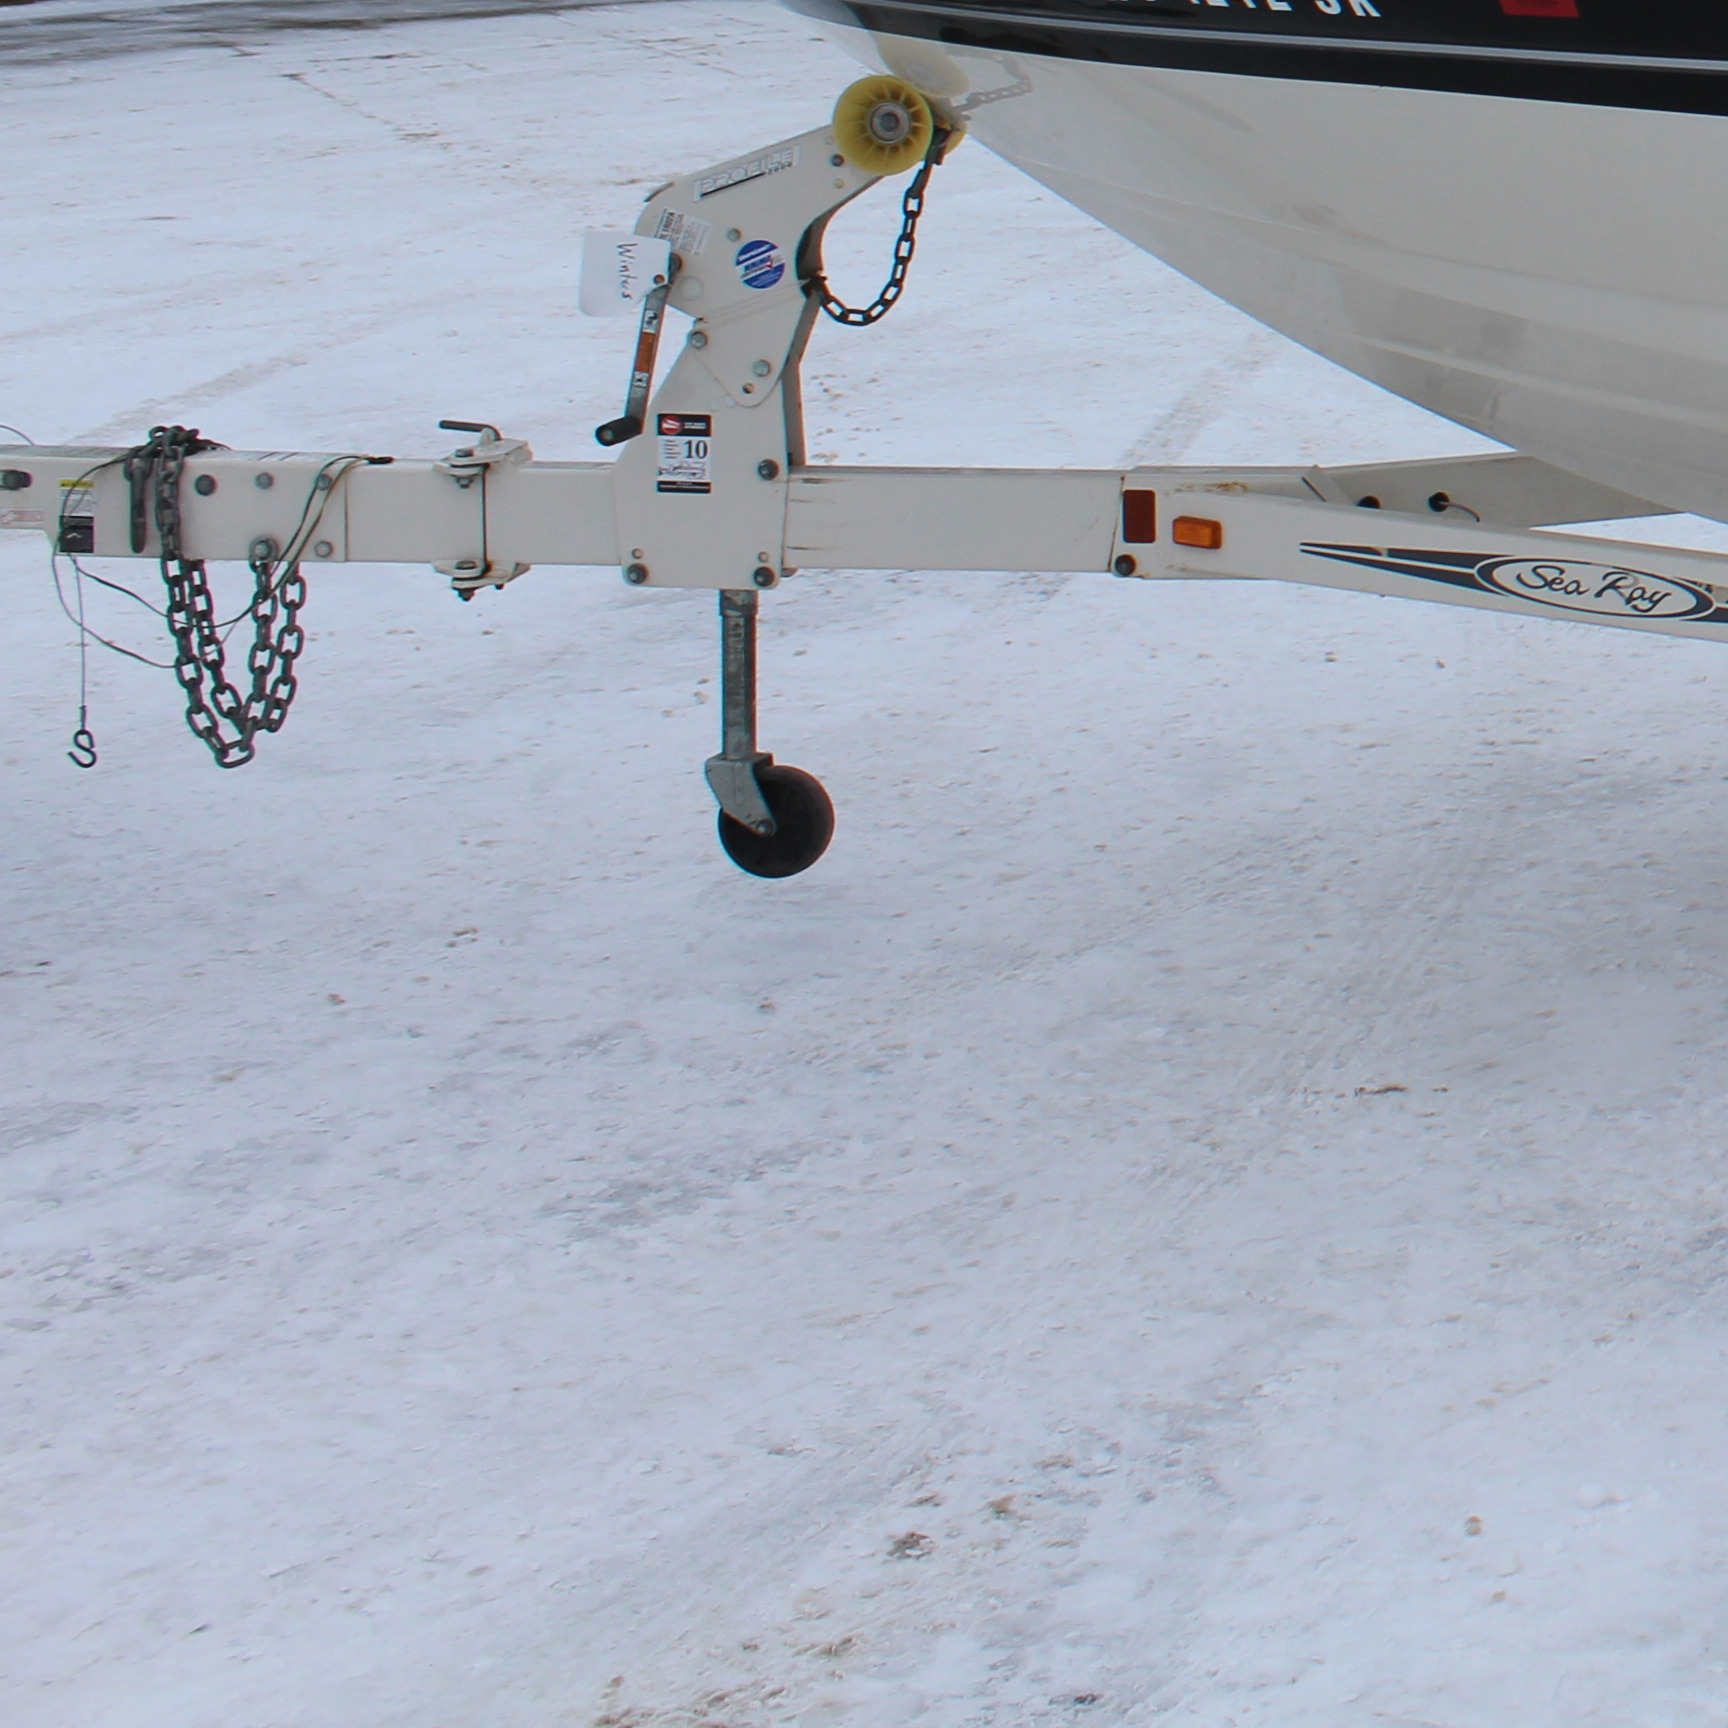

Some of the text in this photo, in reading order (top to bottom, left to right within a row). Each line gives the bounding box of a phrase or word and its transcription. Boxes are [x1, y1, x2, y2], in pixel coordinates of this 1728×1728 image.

[700, 148, 795, 194] PROFILE
[684, 439, 708, 459] 10
[1516, 565, 1672, 613] Sea Ray
